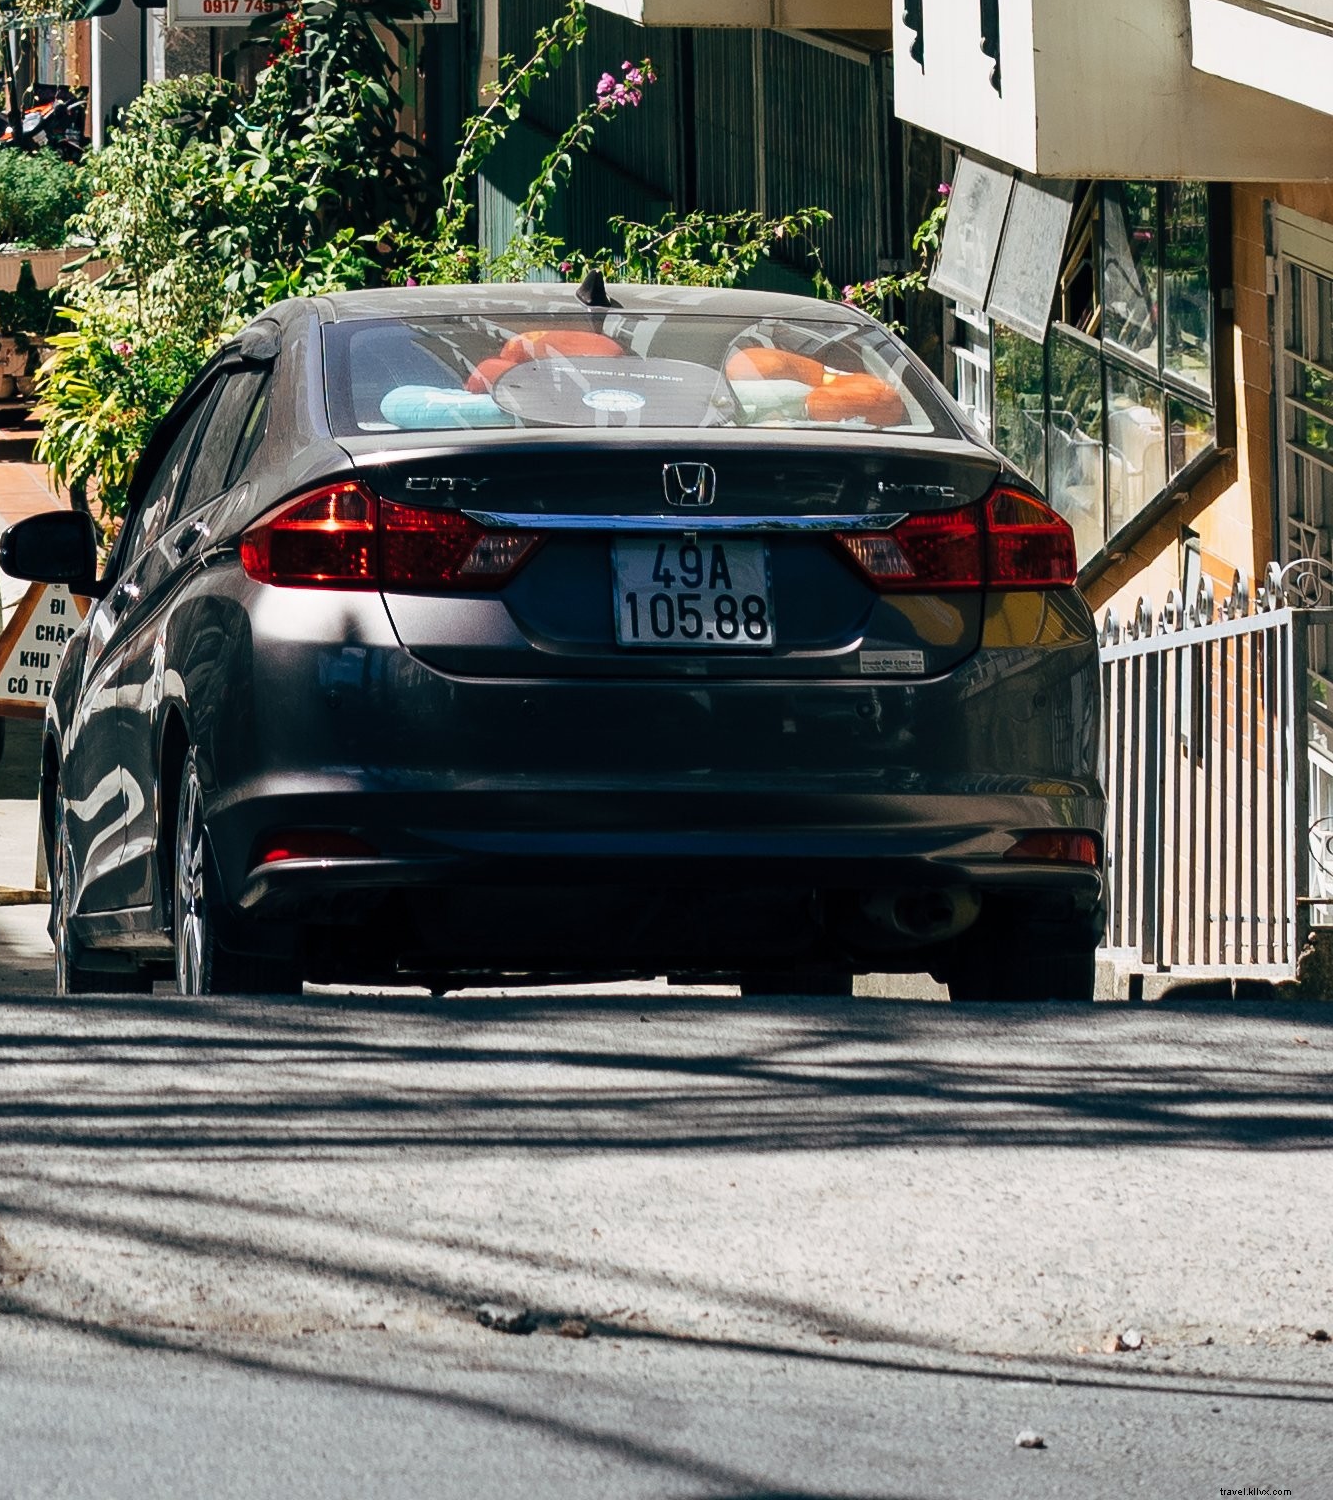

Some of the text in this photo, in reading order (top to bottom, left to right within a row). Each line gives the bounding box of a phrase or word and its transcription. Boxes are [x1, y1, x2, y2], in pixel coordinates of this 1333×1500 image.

[202, 0, 239, 14] 0917
[405, 476, 490, 492] CITY
[651, 542, 733, 590] 49A
[50, 598, 66, 616] ĐI
[625, 591, 769, 641] 105.88
[19, 650, 51, 669] KHU
[7, 674, 29, 695] CÓ
